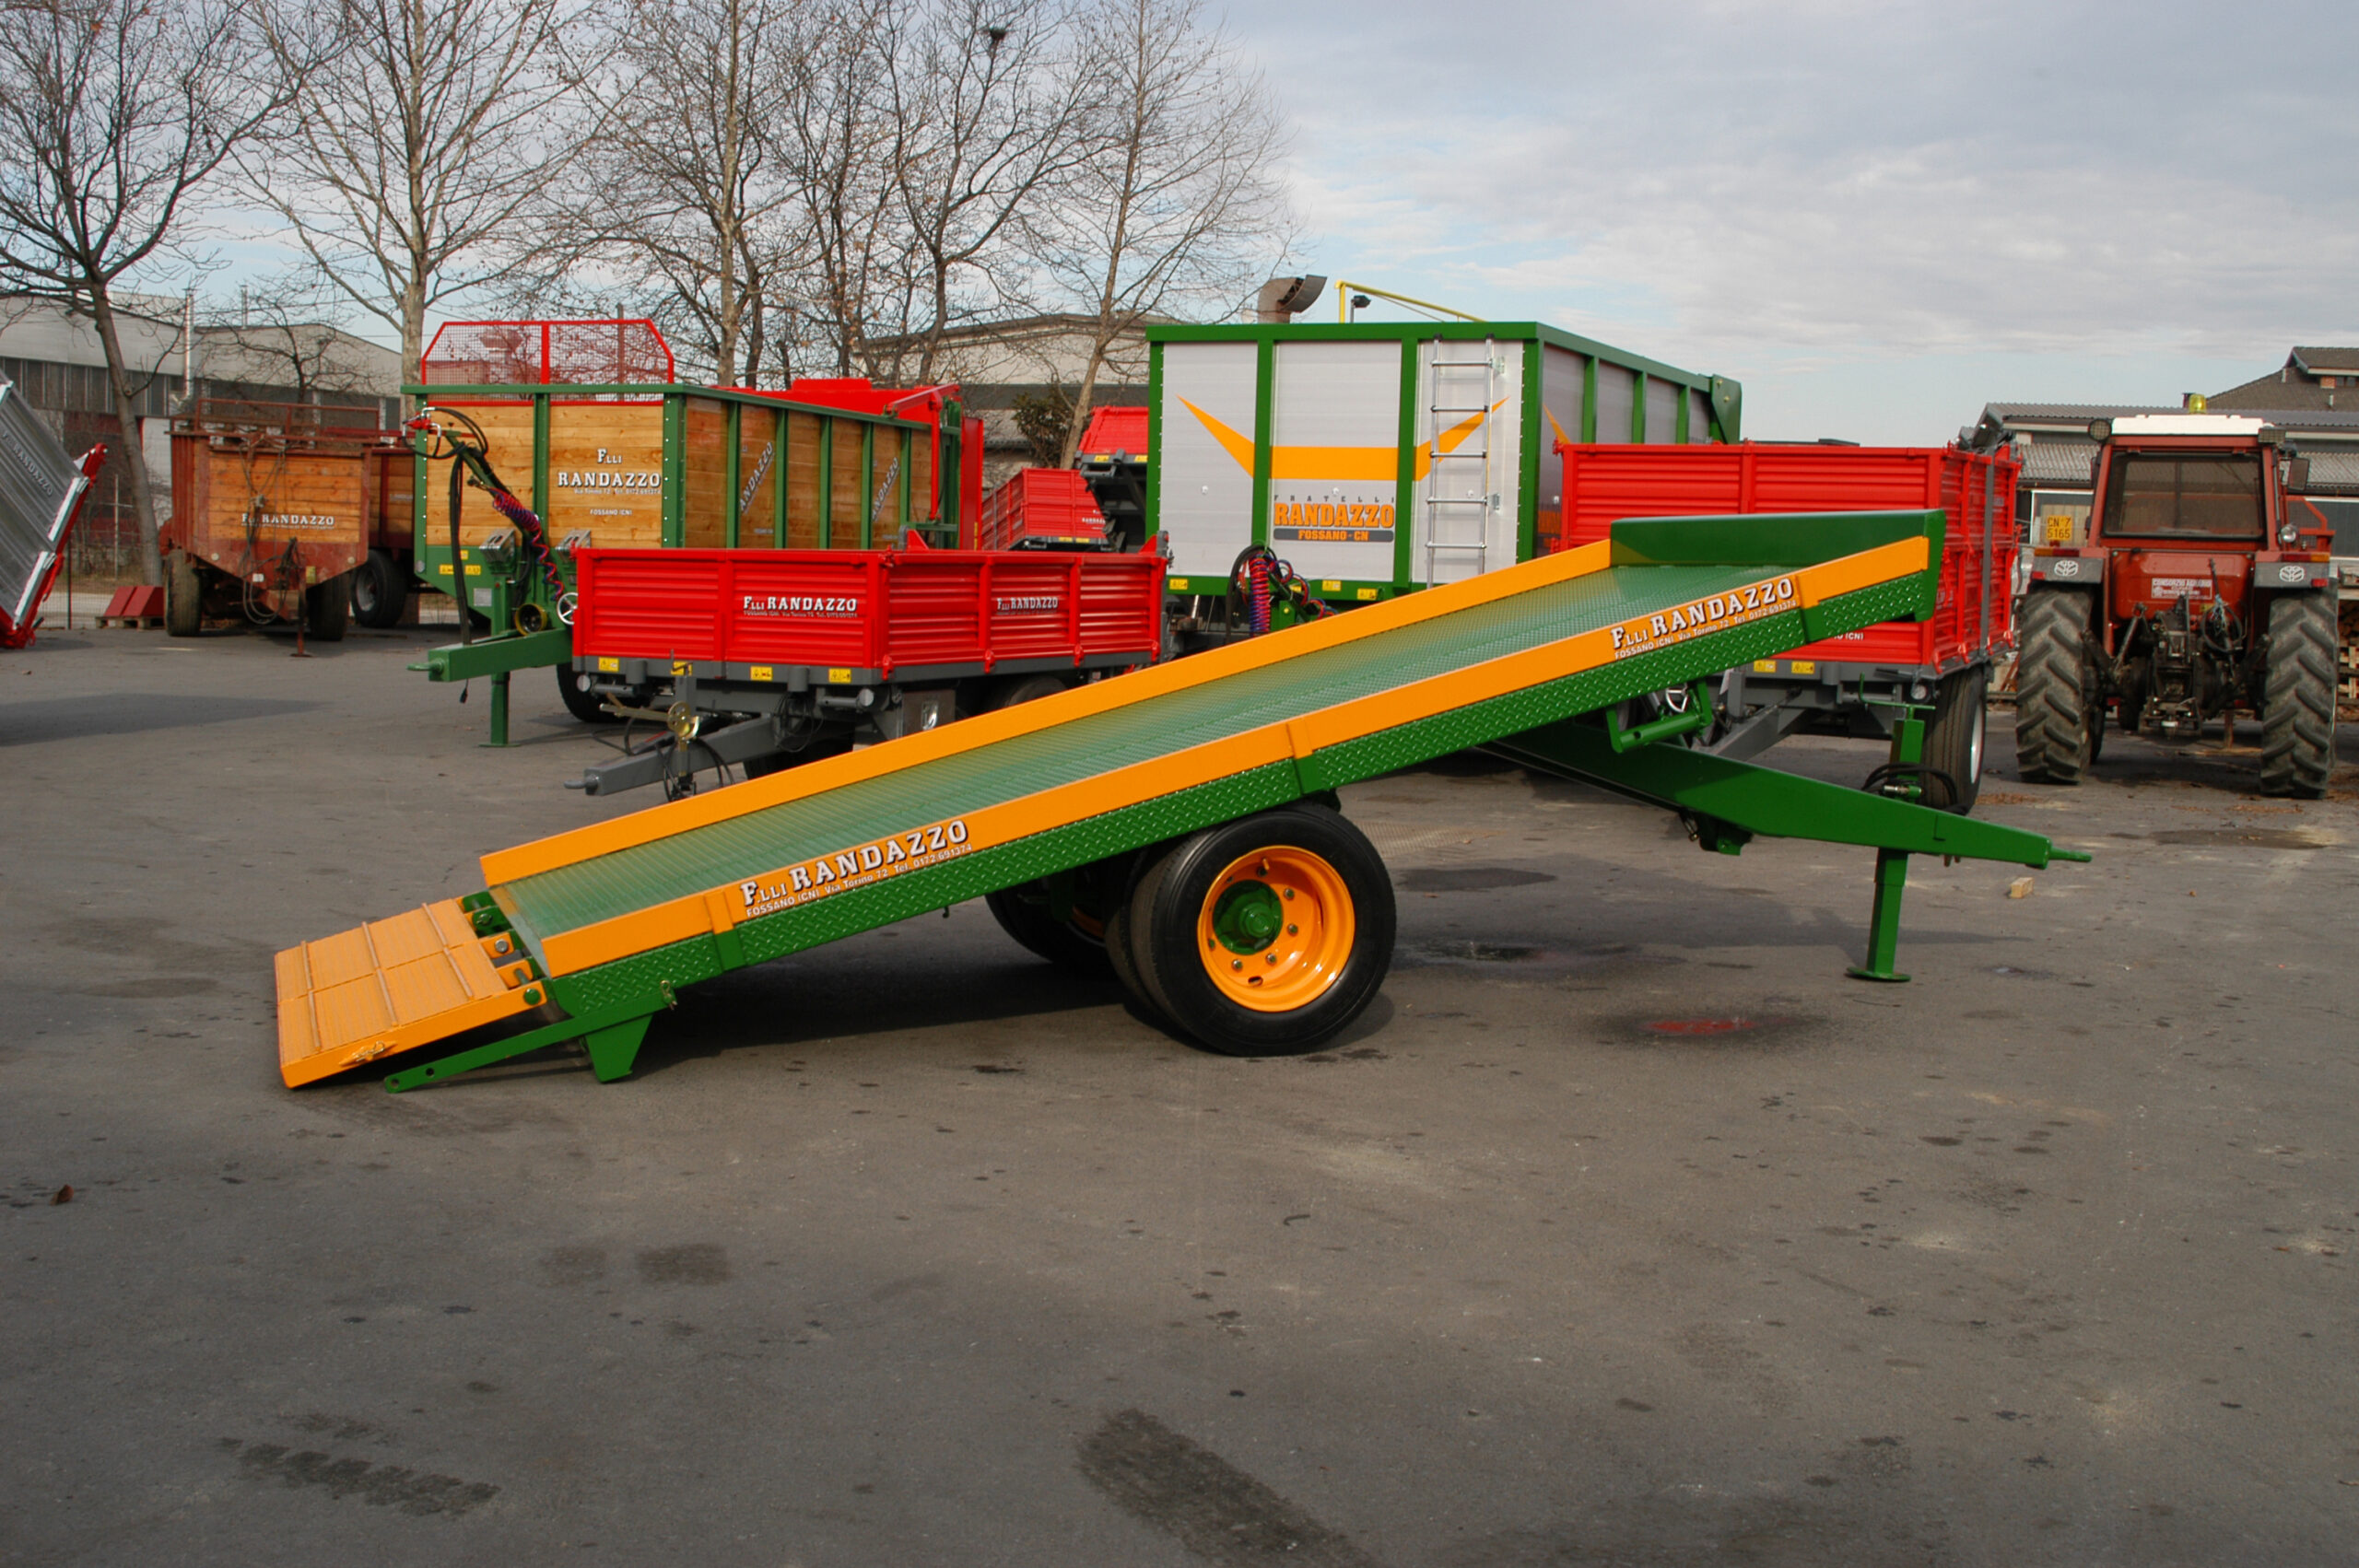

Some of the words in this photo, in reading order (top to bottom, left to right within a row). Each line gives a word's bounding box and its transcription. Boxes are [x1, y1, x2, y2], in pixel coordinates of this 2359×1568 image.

[558, 472, 662, 487] RANDAZZO
[740, 442, 772, 511] ANDAZZO
[262, 513, 334, 525] RANDAZZO
[1274, 502, 1395, 528] RANDAZZO
[2048, 518, 2059, 527] CN
[2048, 528, 2071, 539] 5165
[768, 597, 857, 612] RANDAZZO
[1011, 597, 1059, 610] RANDAZZO
[1611, 626, 1649, 649] F.LLI
[1650, 579, 1793, 638] RANDAZZO
[1614, 641, 1655, 660] FOSSANO
[1678, 632, 1692, 641] Via
[1693, 625, 1719, 637] Torino
[1719, 619, 1730, 628] 72
[740, 881, 788, 907] F.LLI
[789, 820, 968, 892] RANDAZZO
[746, 896, 796, 918] FOSSANO
[825, 884, 840, 895] Via
[843, 874, 874, 889] Torino
[875, 869, 889, 879] 72
[893, 862, 911, 873] Tel.
